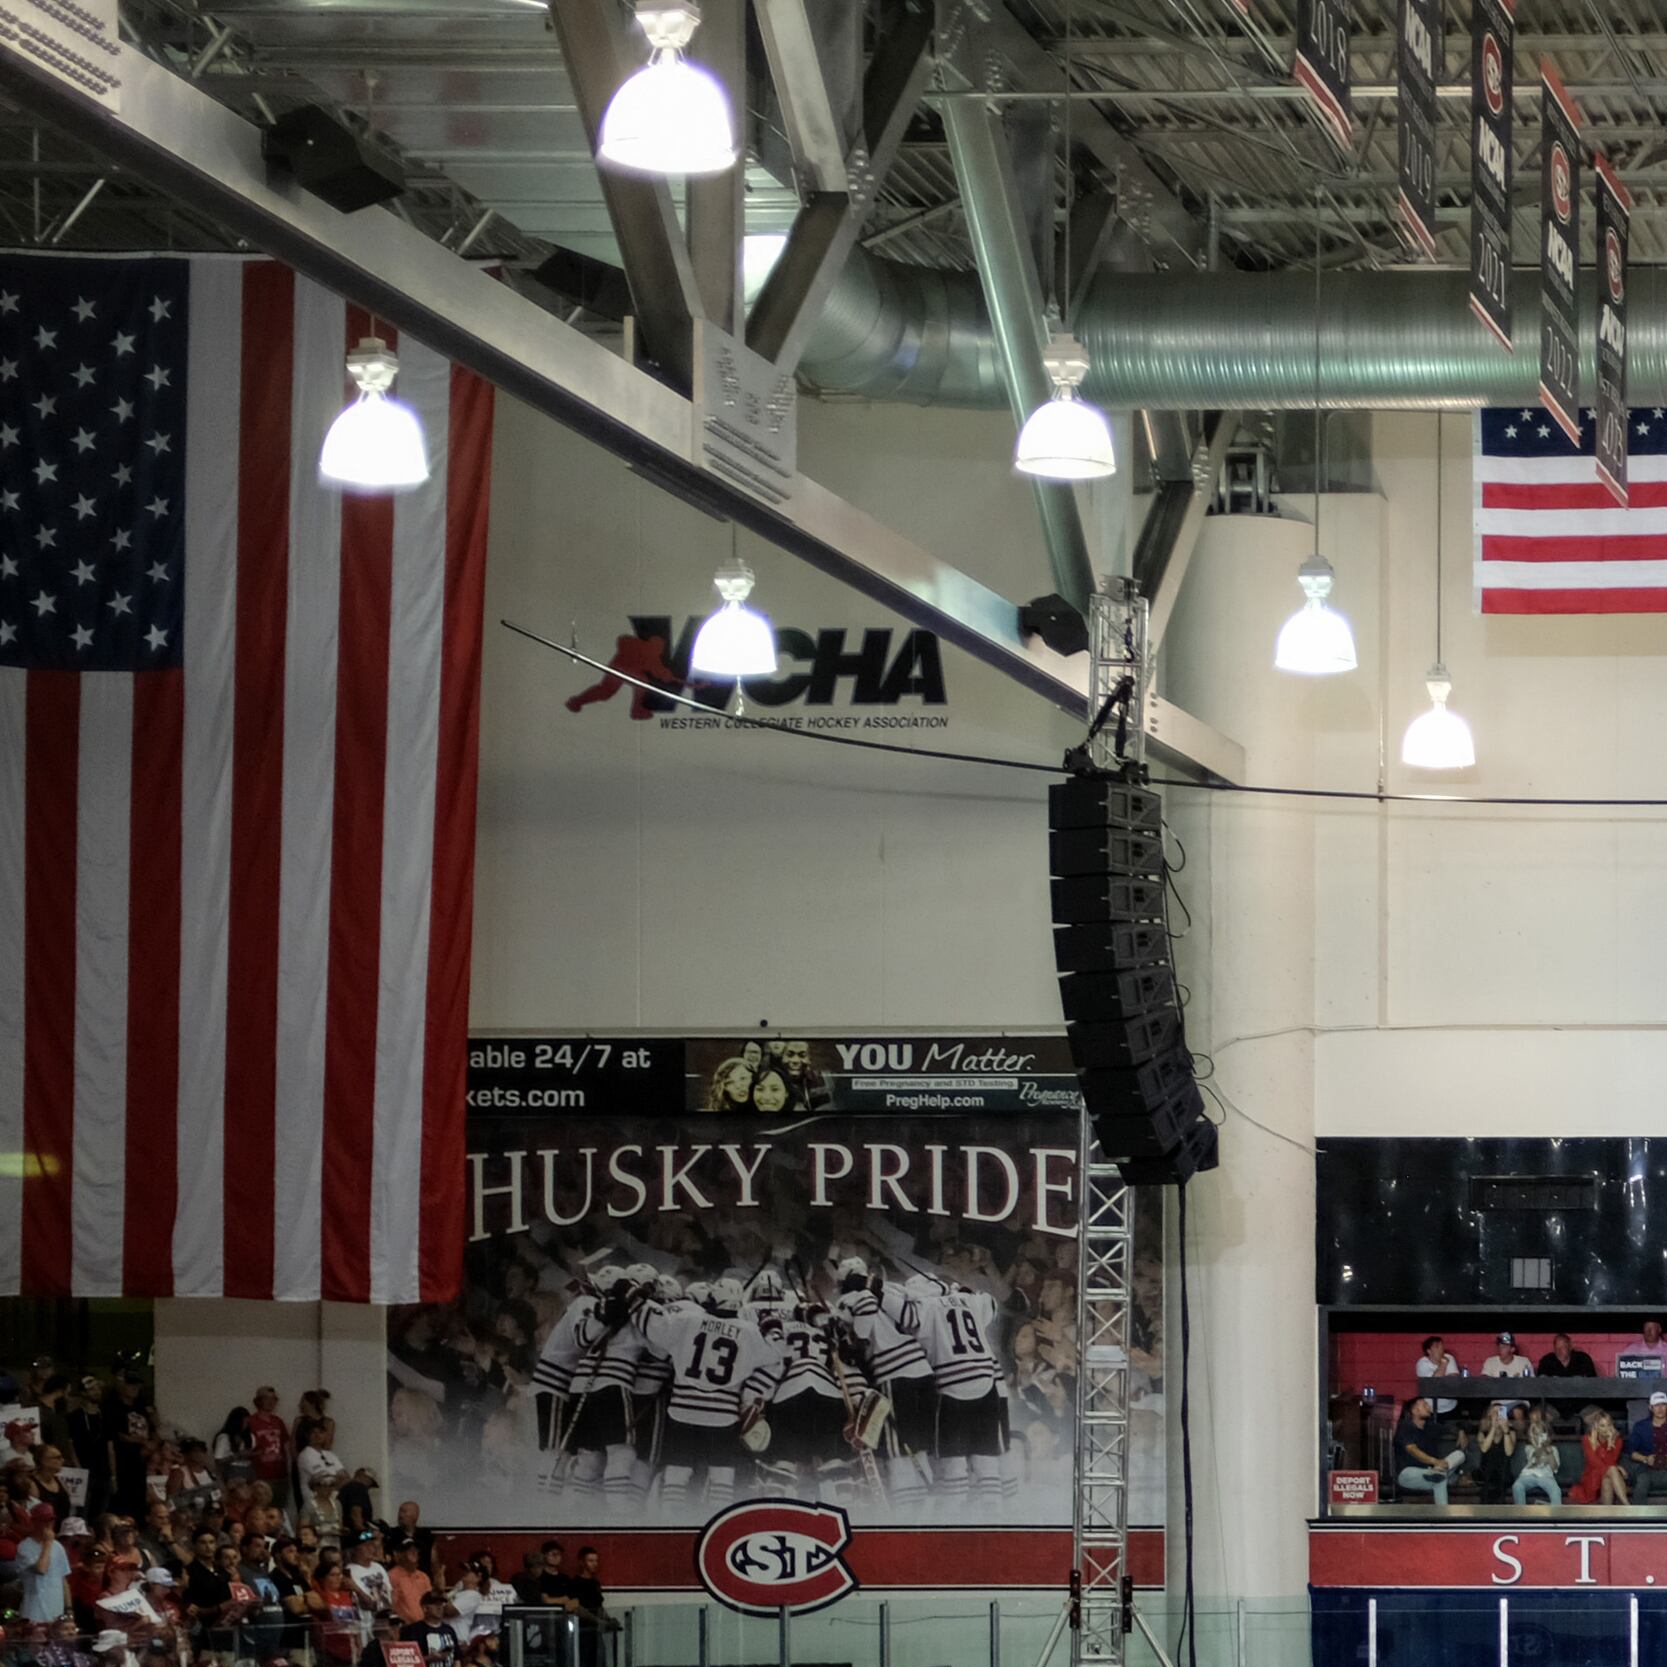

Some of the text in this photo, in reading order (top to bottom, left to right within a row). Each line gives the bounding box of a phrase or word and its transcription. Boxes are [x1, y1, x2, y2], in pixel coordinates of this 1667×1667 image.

[660, 716, 950, 730] WESTERN HOCKEY ASSOCIATION
[533, 1045, 613, 1075] 24/7
[621, 1047, 652, 1070] at
[836, 1042, 1036, 1074] YOU Matter.
[854, 1079, 974, 1092] Free Pregnancy and STD
[1018, 1080, 1080, 1108] Pregnancy
[886, 1092, 985, 1110] PregHelp.com
[468, 1142, 1079, 1244] HUSKY PRIDE
[700, 1321, 742, 1340] MORLEY
[946, 1308, 985, 1356] 19
[683, 1334, 741, 1387] 13
[1619, 1361, 1643, 1369] BACK
[1619, 1370, 1637, 1378] THE
[1333, 1484, 1374, 1492] ILLEGALS
[1335, 1476, 1370, 1485] DEPORT
[1342, 1491, 1365, 1499] NOW
[1491, 1534, 1656, 1585] ST.
